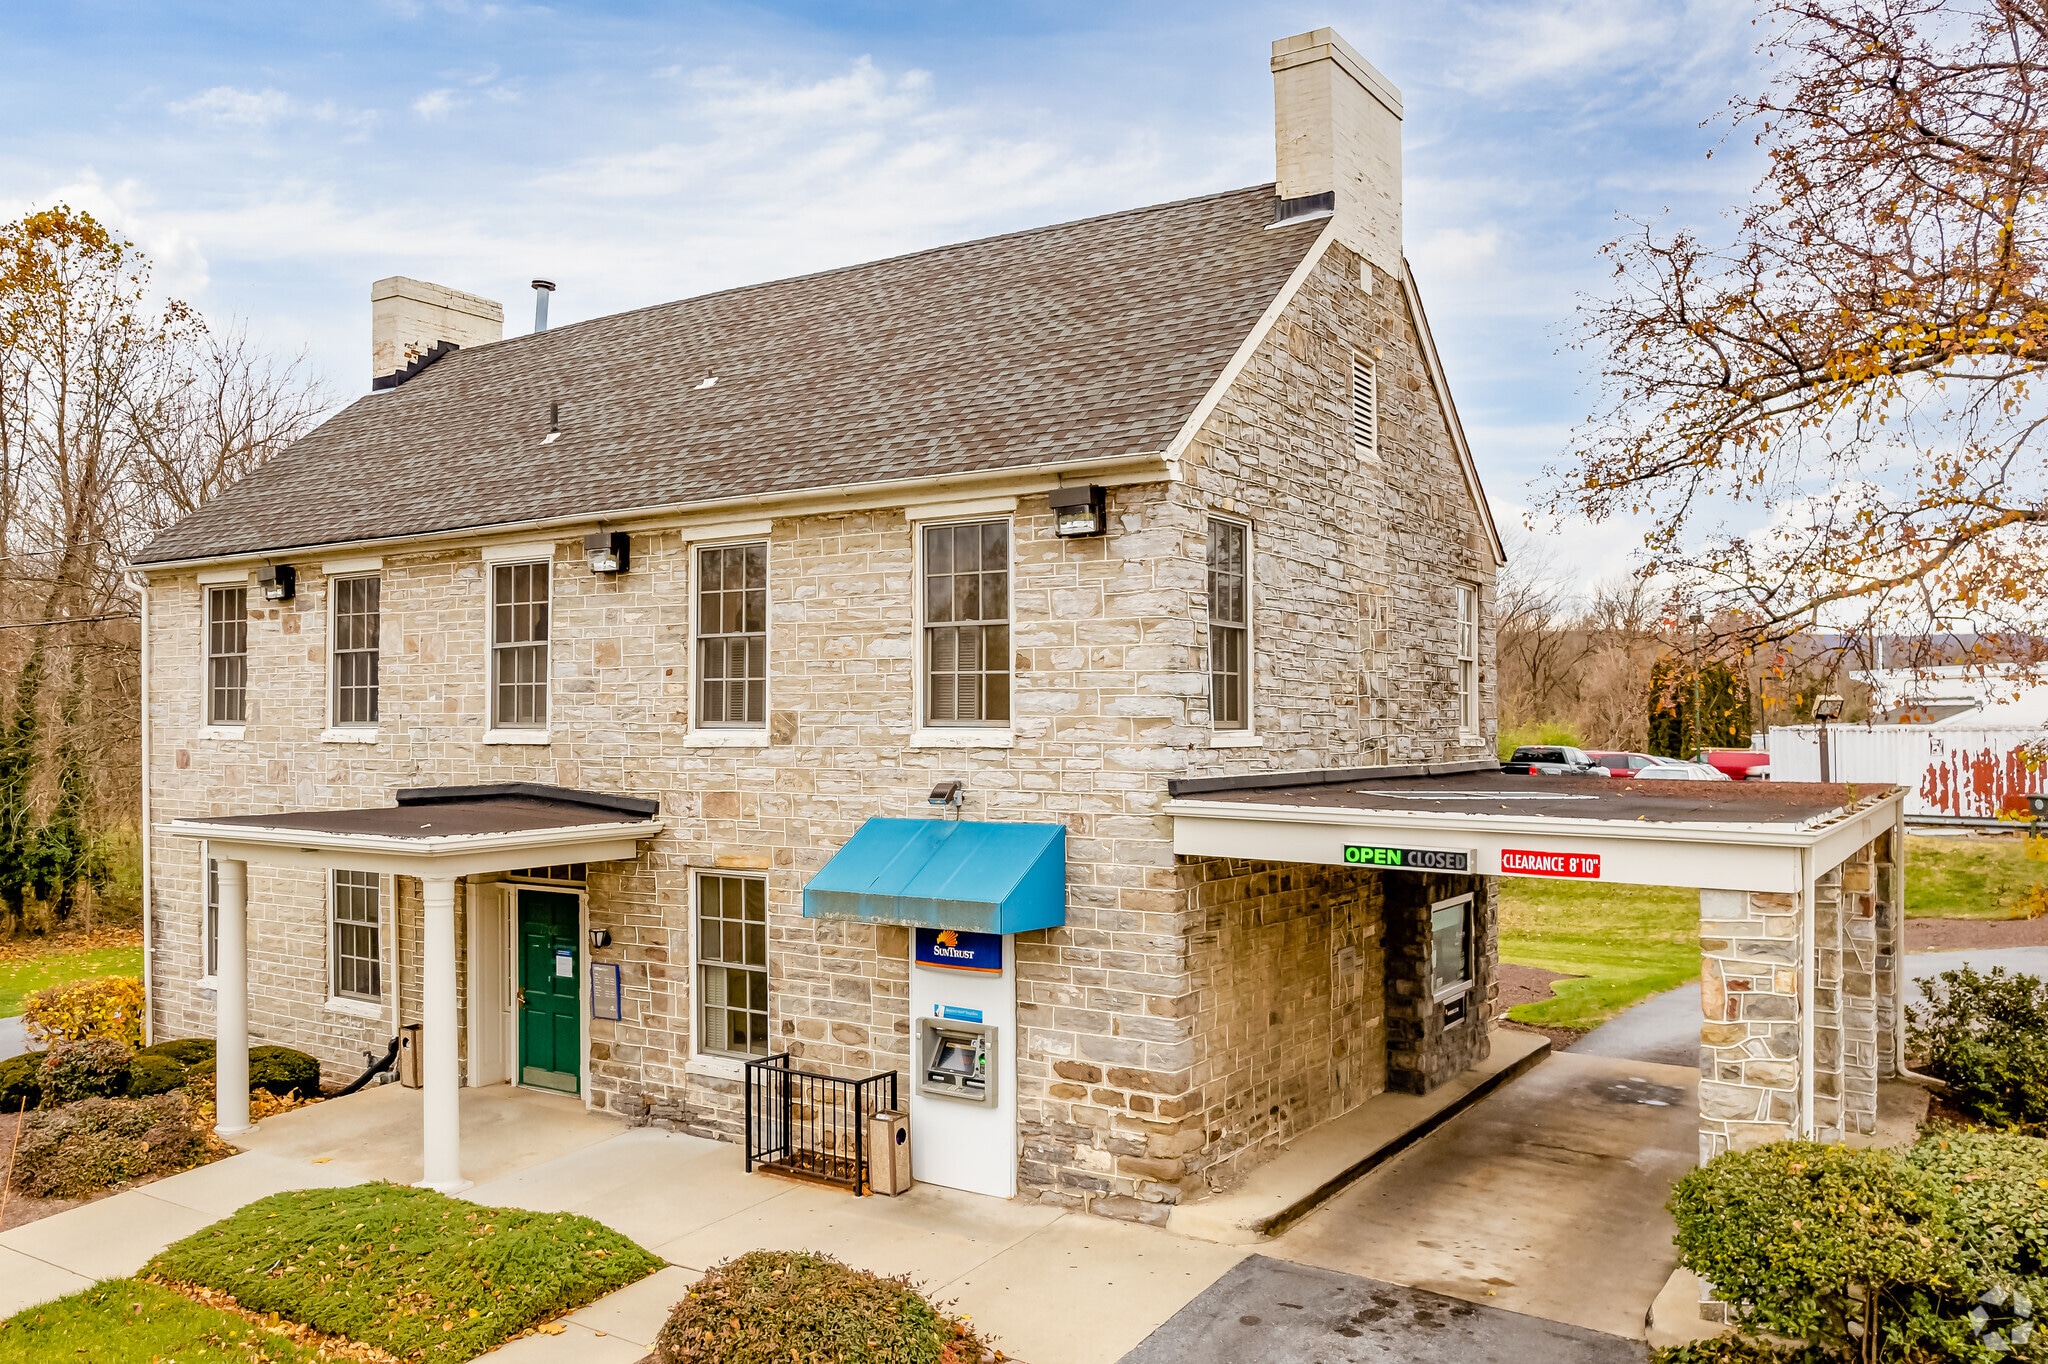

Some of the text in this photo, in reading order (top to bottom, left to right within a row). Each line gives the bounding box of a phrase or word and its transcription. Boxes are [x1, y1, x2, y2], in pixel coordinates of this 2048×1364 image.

[1346, 847, 1466, 869] OPEN CLOSED
[1503, 854, 1564, 871] CLEARANCE
